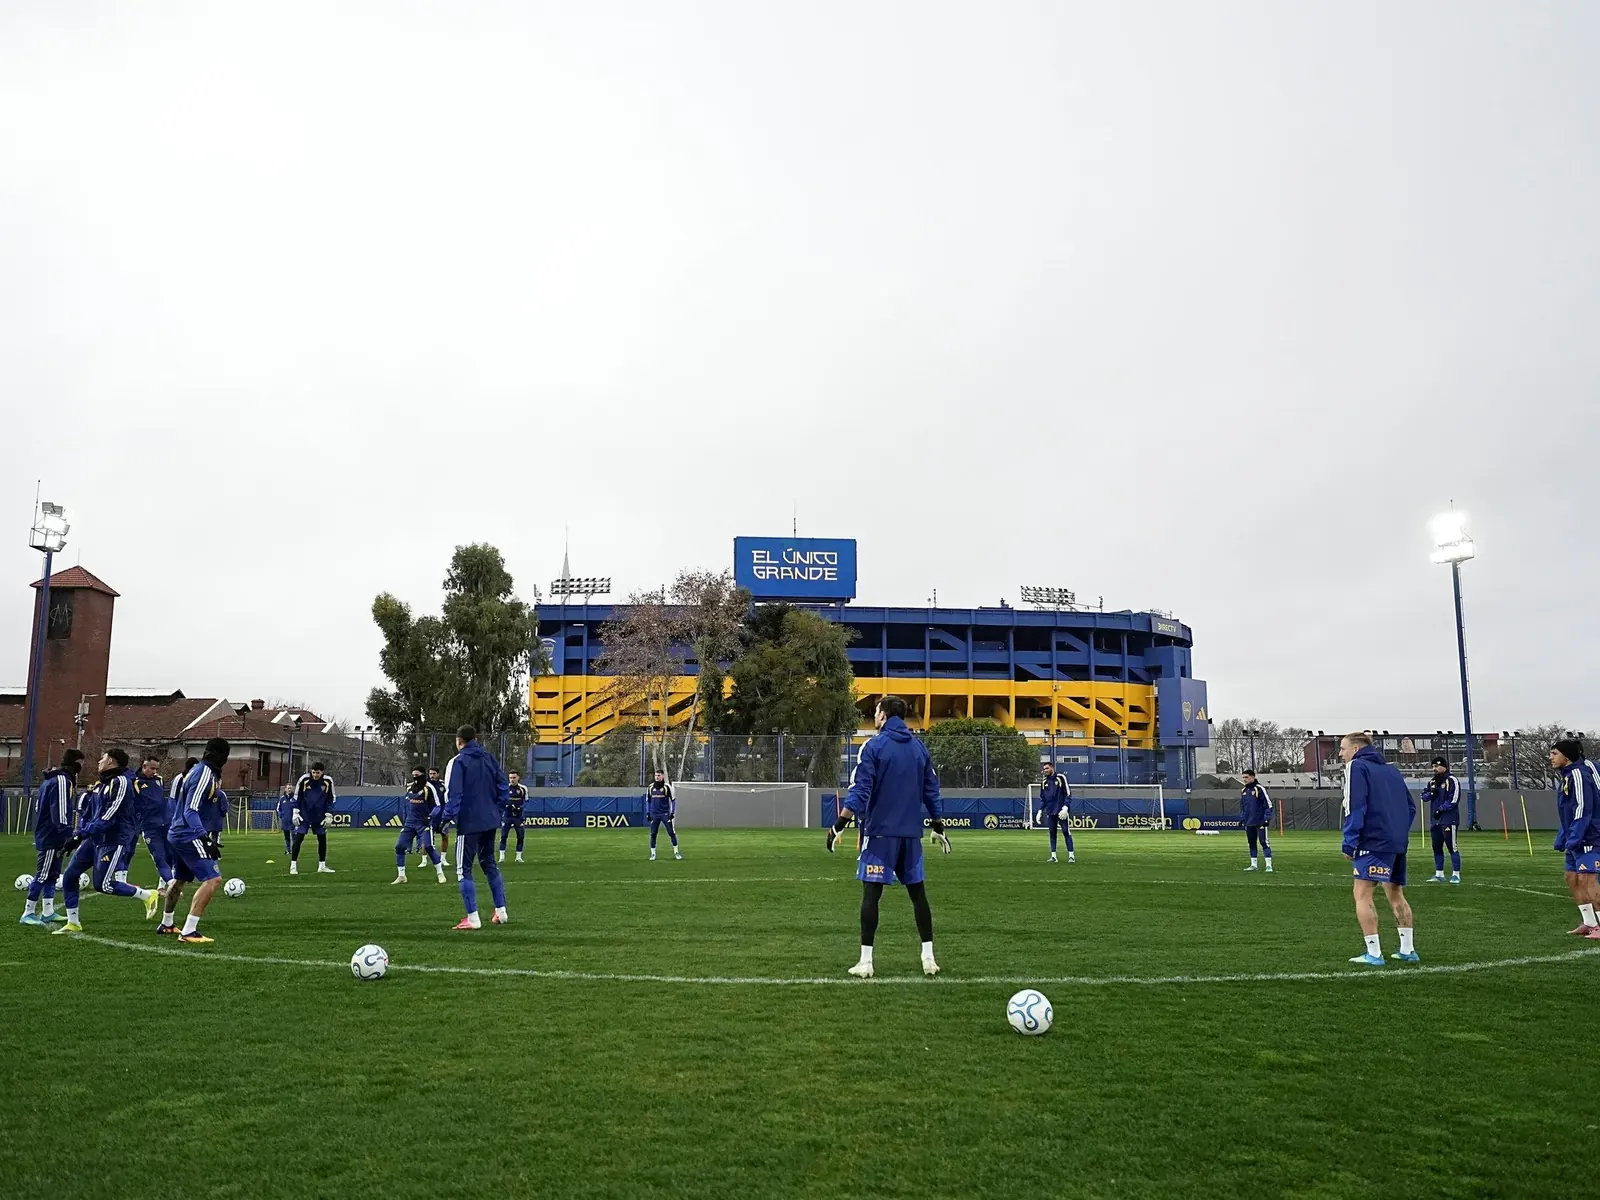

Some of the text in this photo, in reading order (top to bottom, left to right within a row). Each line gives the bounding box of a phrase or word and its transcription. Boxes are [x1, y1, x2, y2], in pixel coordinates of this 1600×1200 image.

[752, 548, 838, 565] EL ÚNICO
[753, 566, 838, 581] GRANDE
[585, 814, 630, 828] BBVA
[923, 818, 971, 827] CROGAR
[866, 864, 885, 874] pax
[1368, 865, 1391, 875] pax
